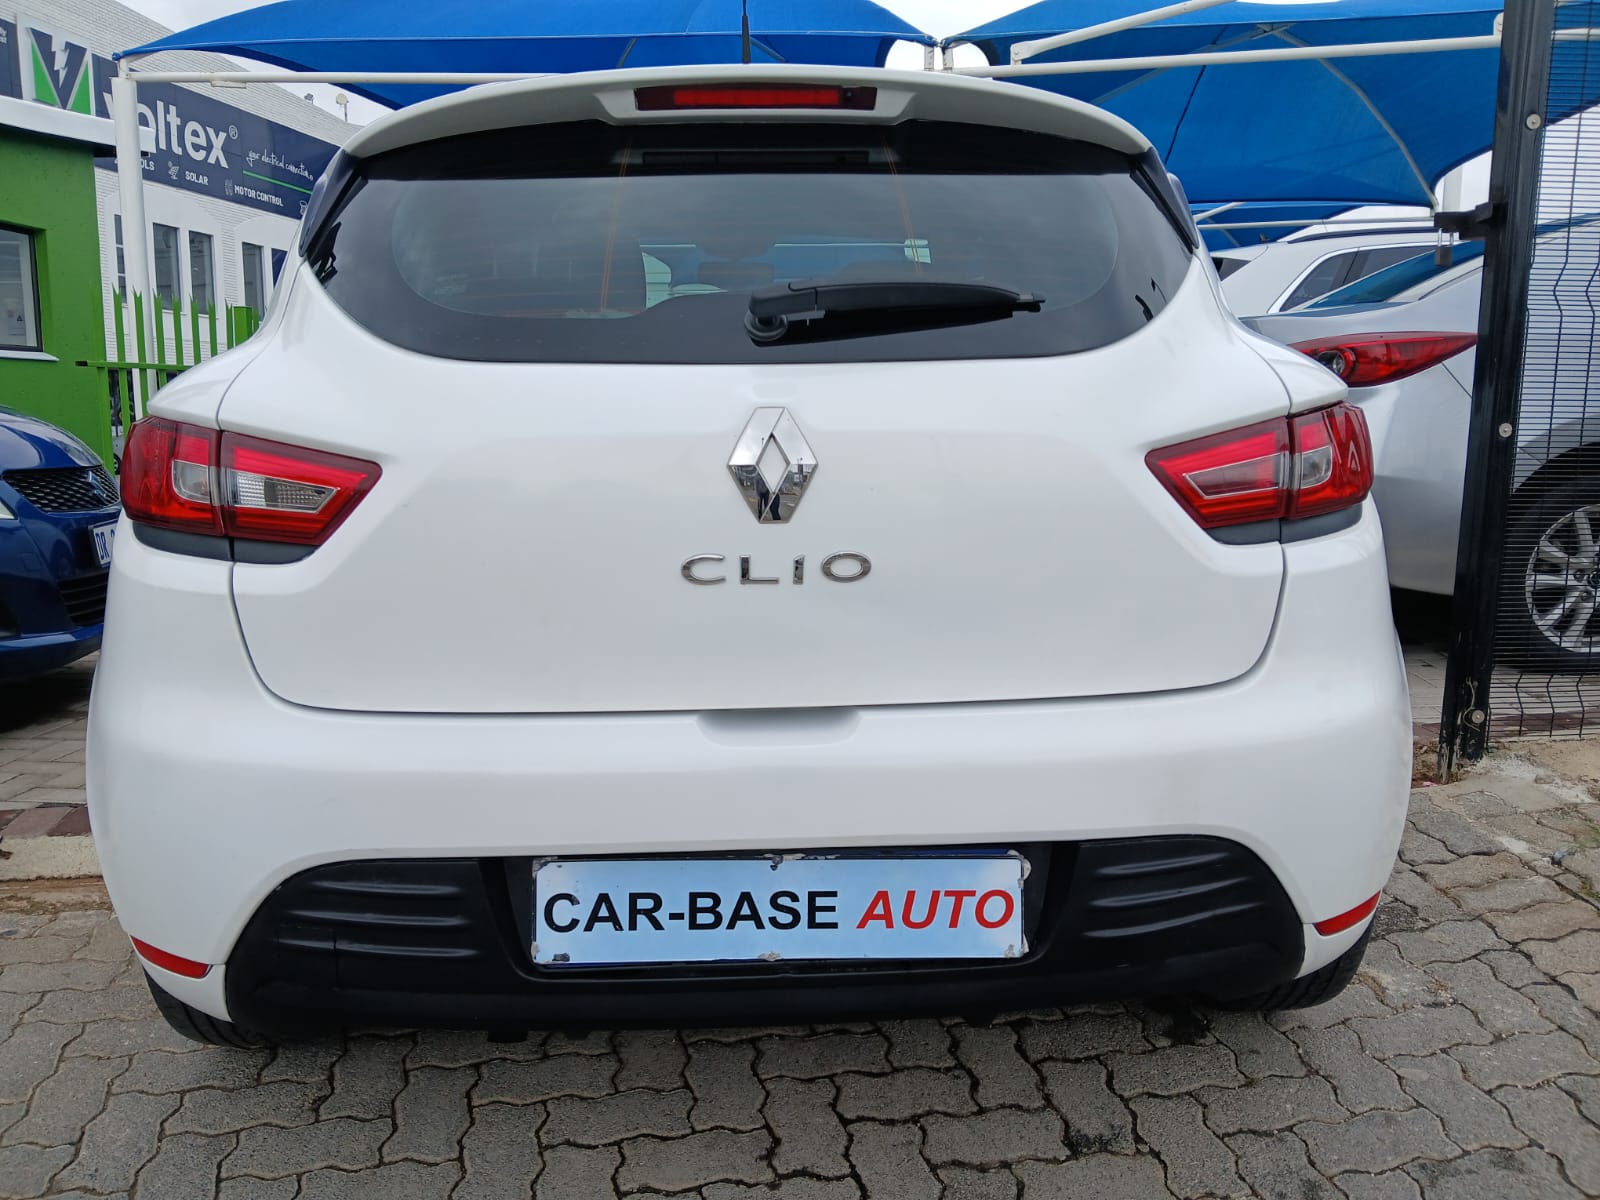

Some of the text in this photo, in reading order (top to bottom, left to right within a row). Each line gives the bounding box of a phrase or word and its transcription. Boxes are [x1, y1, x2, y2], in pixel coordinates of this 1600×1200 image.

[185, 171, 209, 185] SOLAR
[234, 184, 284, 207] MOTOR CONTROL
[680, 550, 872, 585] CLIO
[543, 888, 1015, 933] CAR-BASE AUTO
